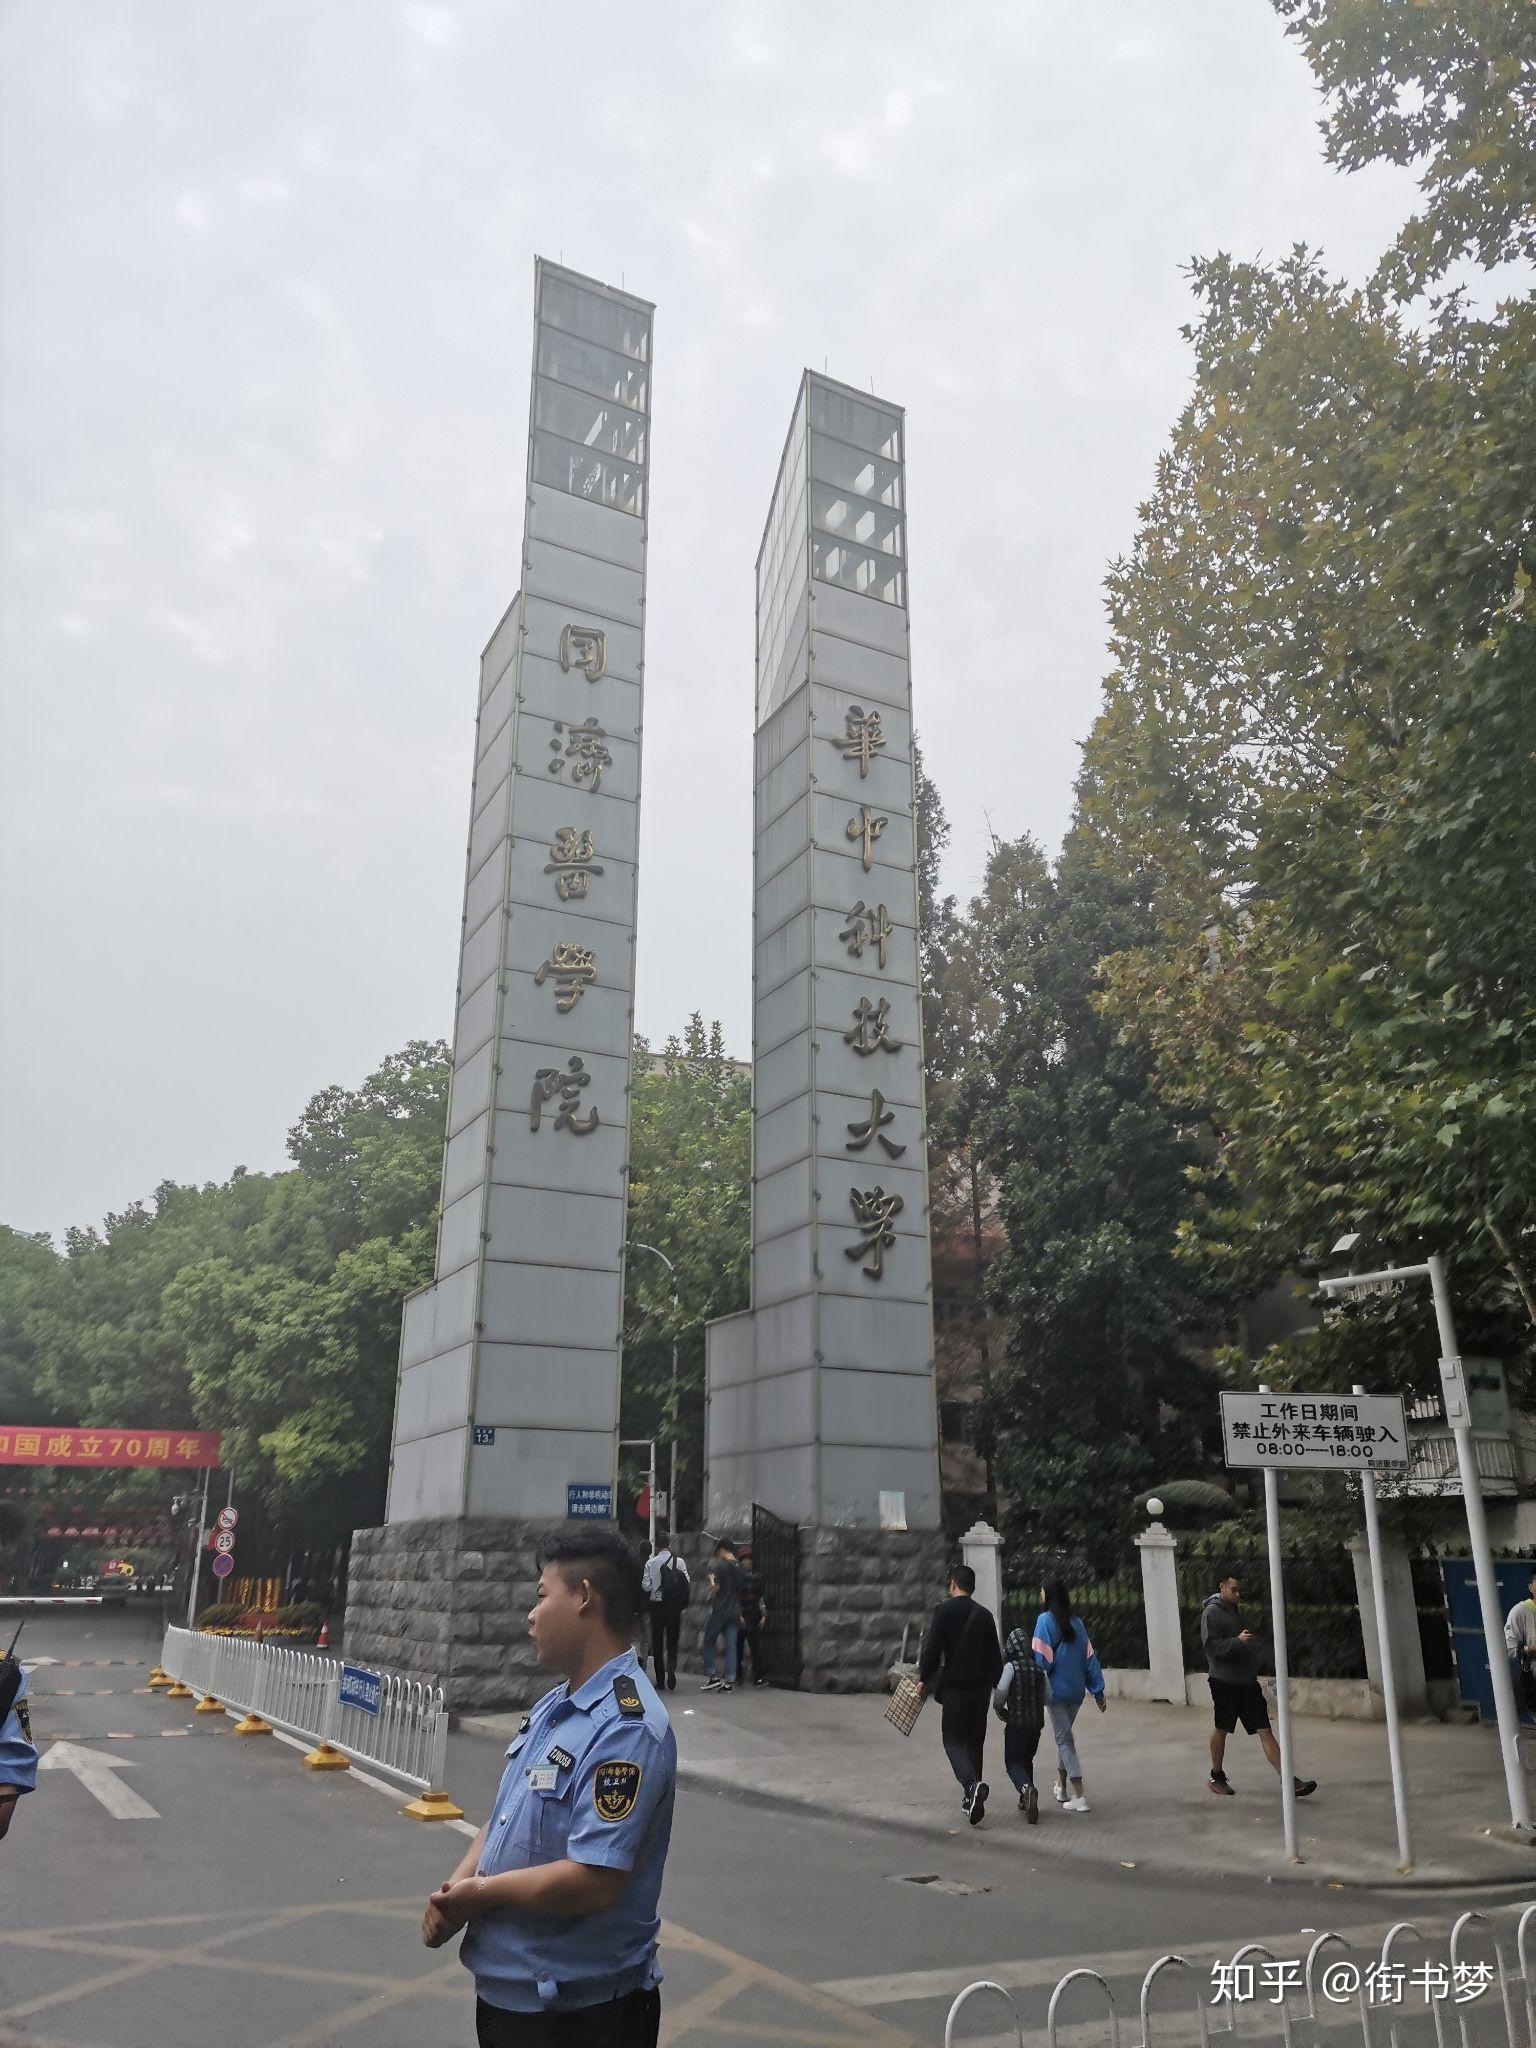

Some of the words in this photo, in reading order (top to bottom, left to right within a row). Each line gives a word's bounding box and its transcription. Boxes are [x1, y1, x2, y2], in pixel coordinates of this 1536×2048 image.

[1260, 1402, 1359, 1421] 工作日期间
[1232, 1421, 1399, 1443] 禁止外来车辆驶入
[219, 1536, 231, 1547] 25
